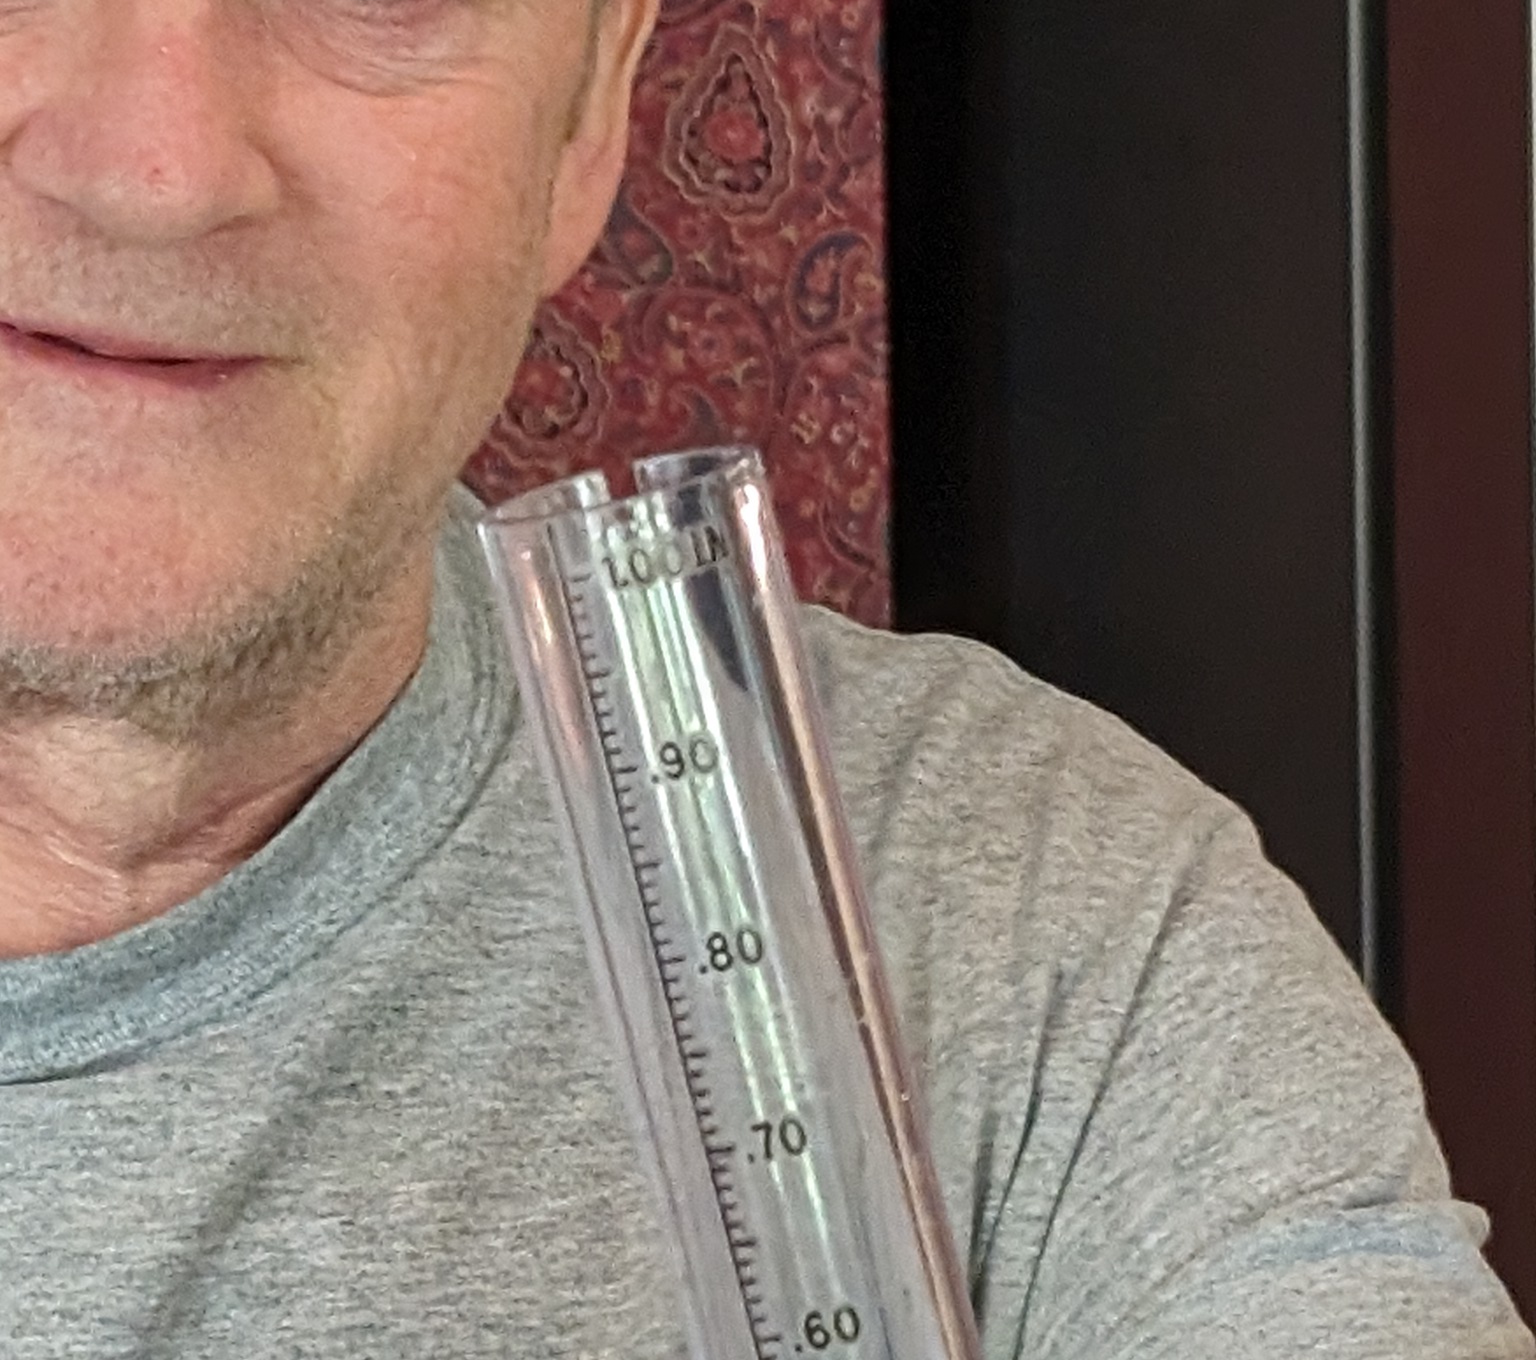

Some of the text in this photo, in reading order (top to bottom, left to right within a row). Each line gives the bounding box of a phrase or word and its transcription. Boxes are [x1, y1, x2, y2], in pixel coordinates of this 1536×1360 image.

[651, 736, 718, 784] .90
[698, 930, 763, 975] .80
[747, 1117, 808, 1163] .70
[794, 1305, 861, 1353] .60
